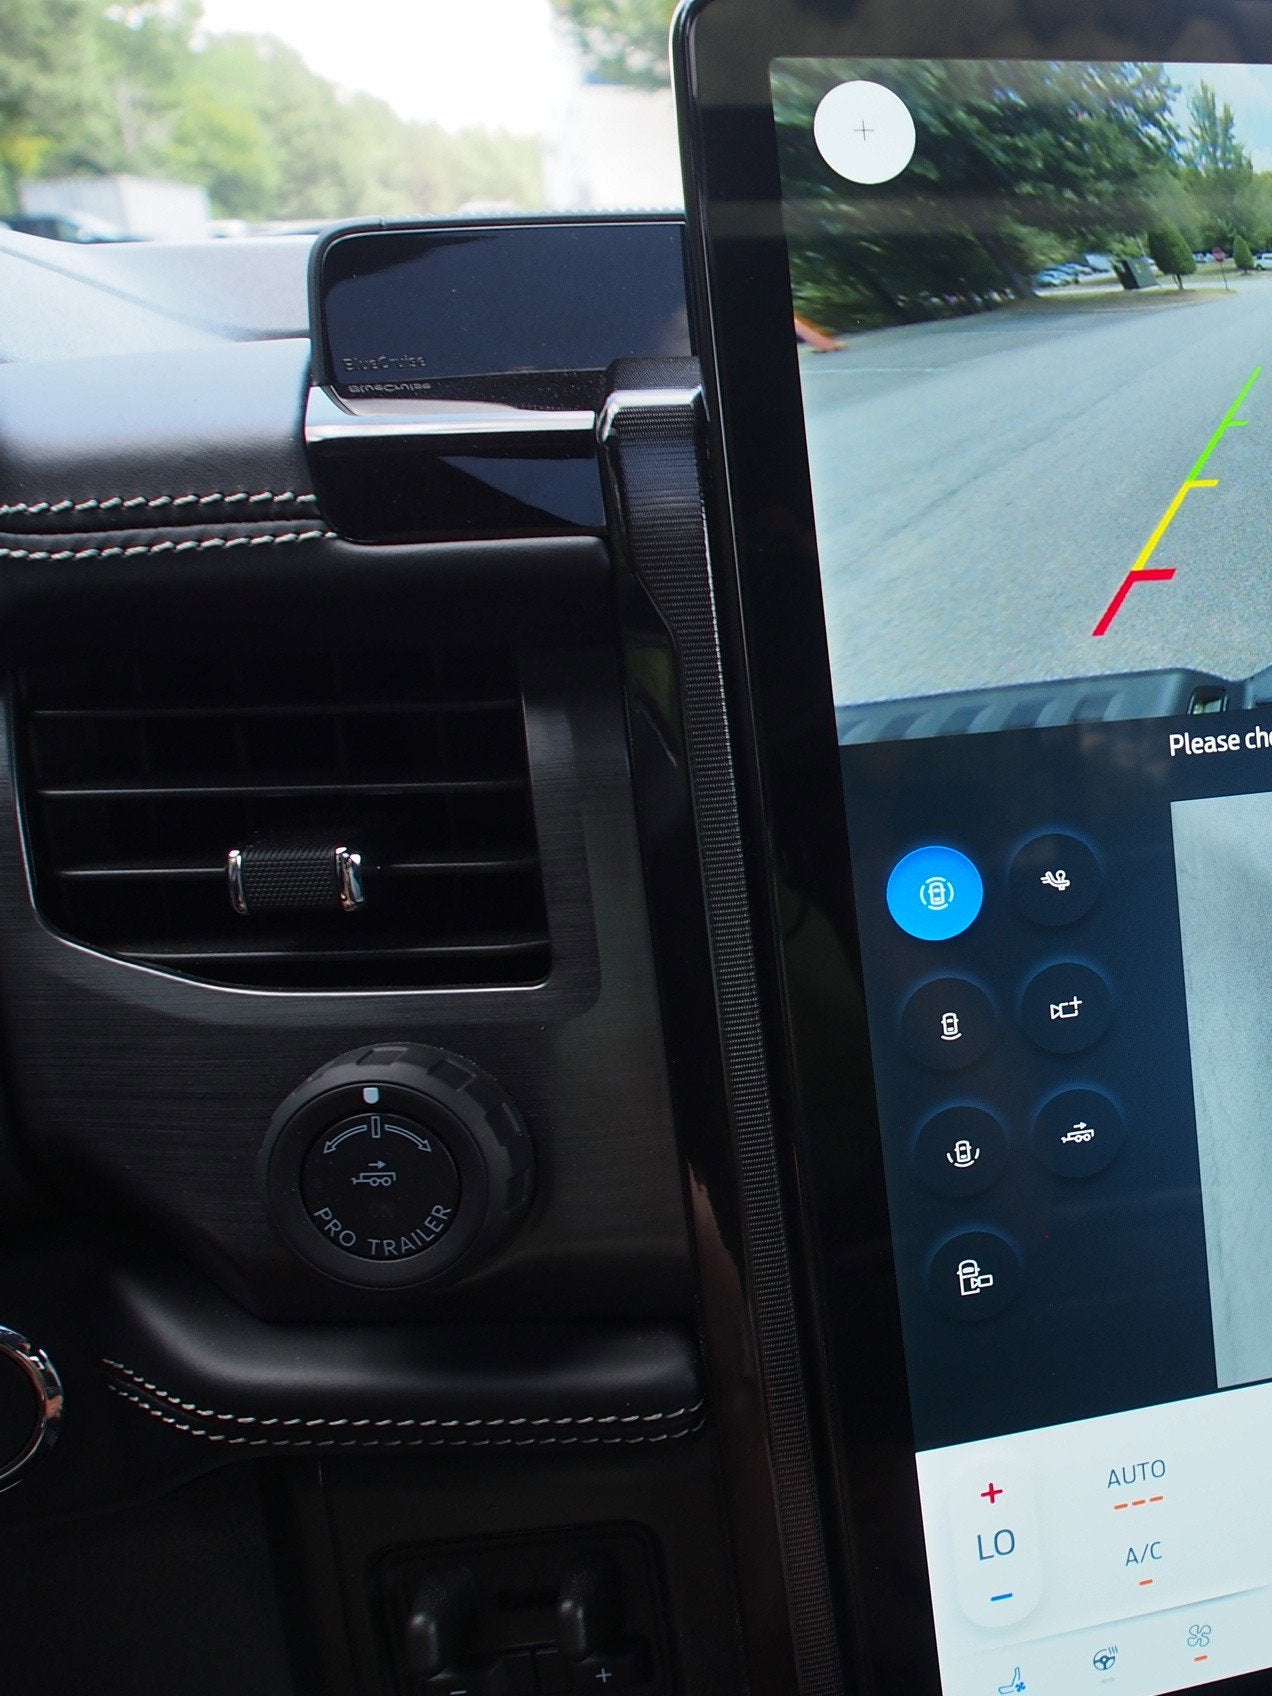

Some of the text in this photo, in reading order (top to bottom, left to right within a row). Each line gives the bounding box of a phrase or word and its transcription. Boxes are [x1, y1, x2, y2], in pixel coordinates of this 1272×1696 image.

[1169, 733, 1240, 757] Please
[314, 1204, 452, 1256] PRO TRAILER
[1107, 1459, 1166, 1488] AUTO
[977, 1529, 1016, 1561] LO
[1125, 1541, 1163, 1567] A/C
